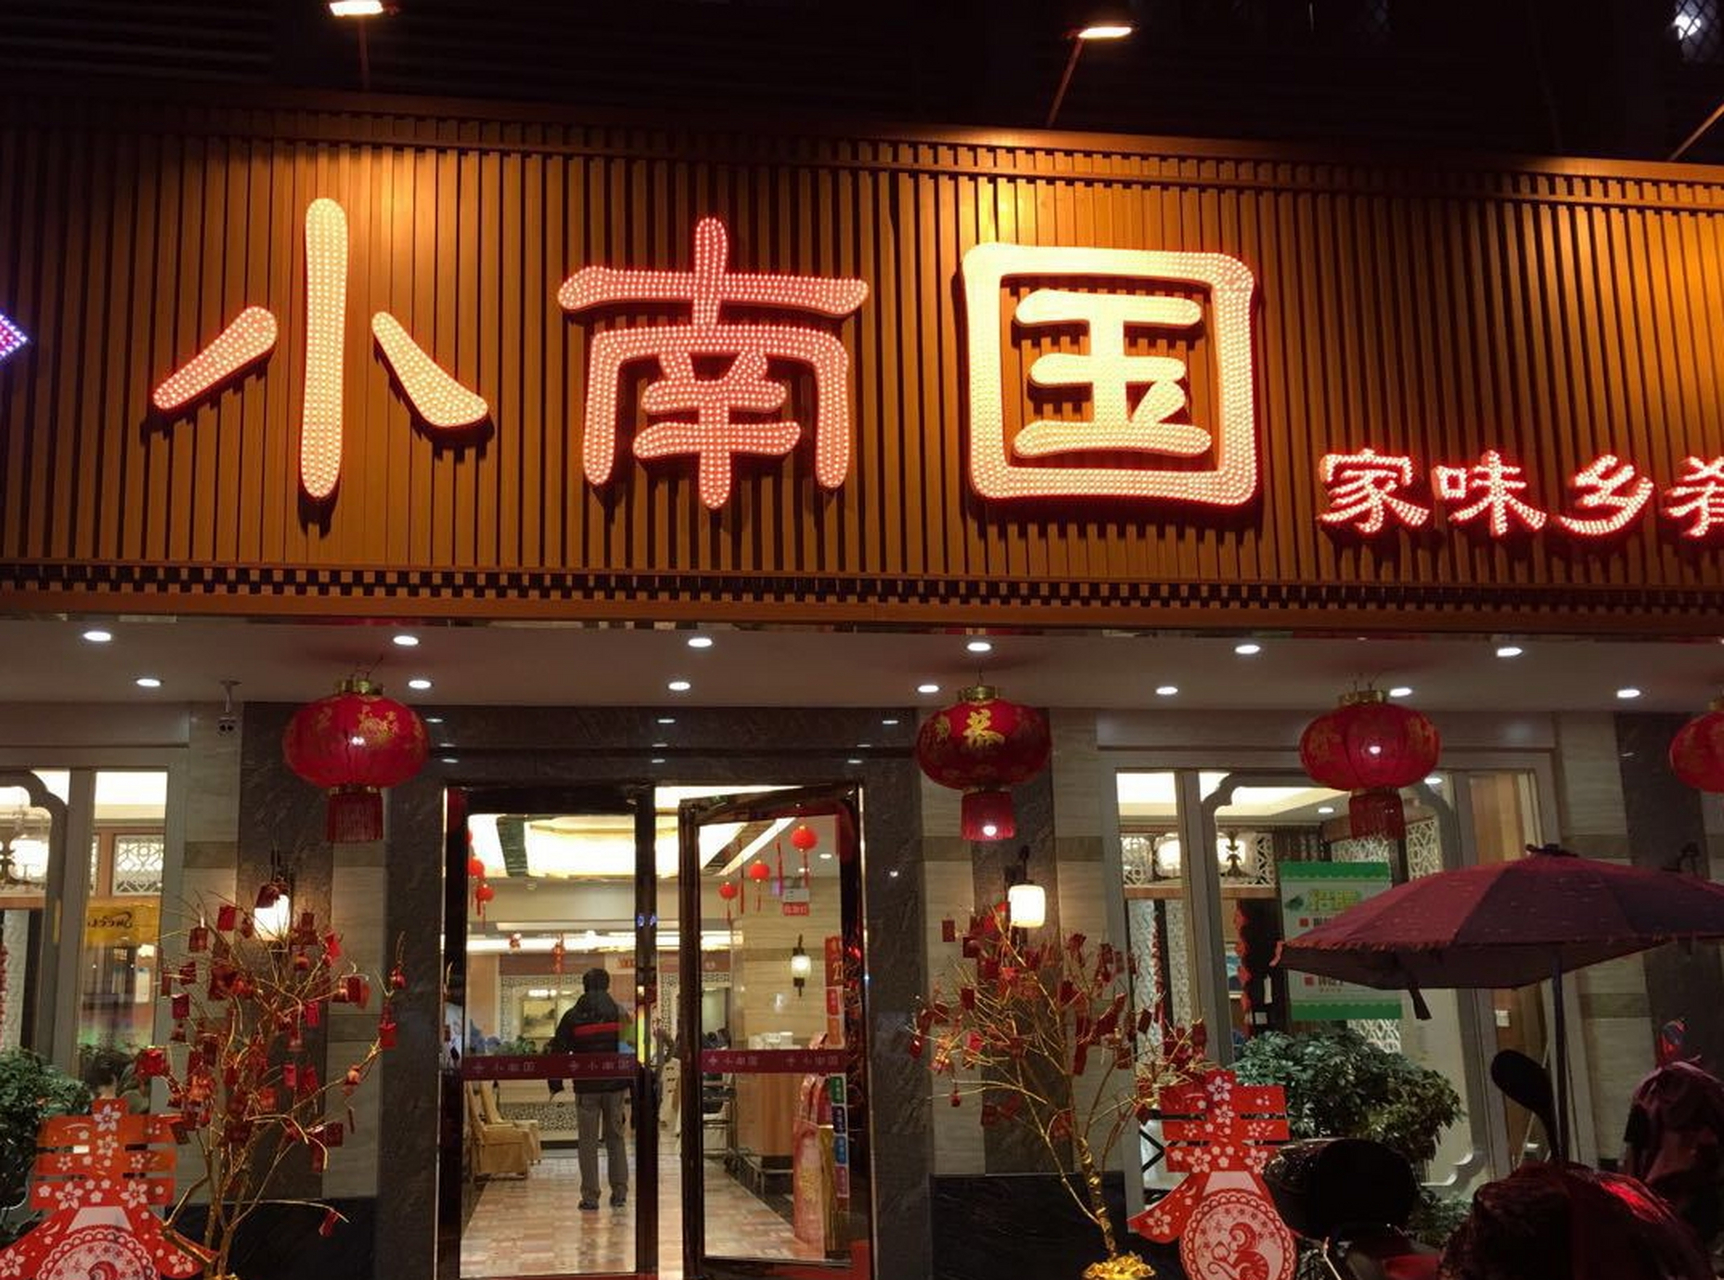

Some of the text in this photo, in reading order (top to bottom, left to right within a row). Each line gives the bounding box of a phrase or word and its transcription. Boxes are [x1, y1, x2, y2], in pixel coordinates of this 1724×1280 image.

[151, 196, 1258, 511] 小南国
[1317, 447, 1724, 537] 家味乡肴
